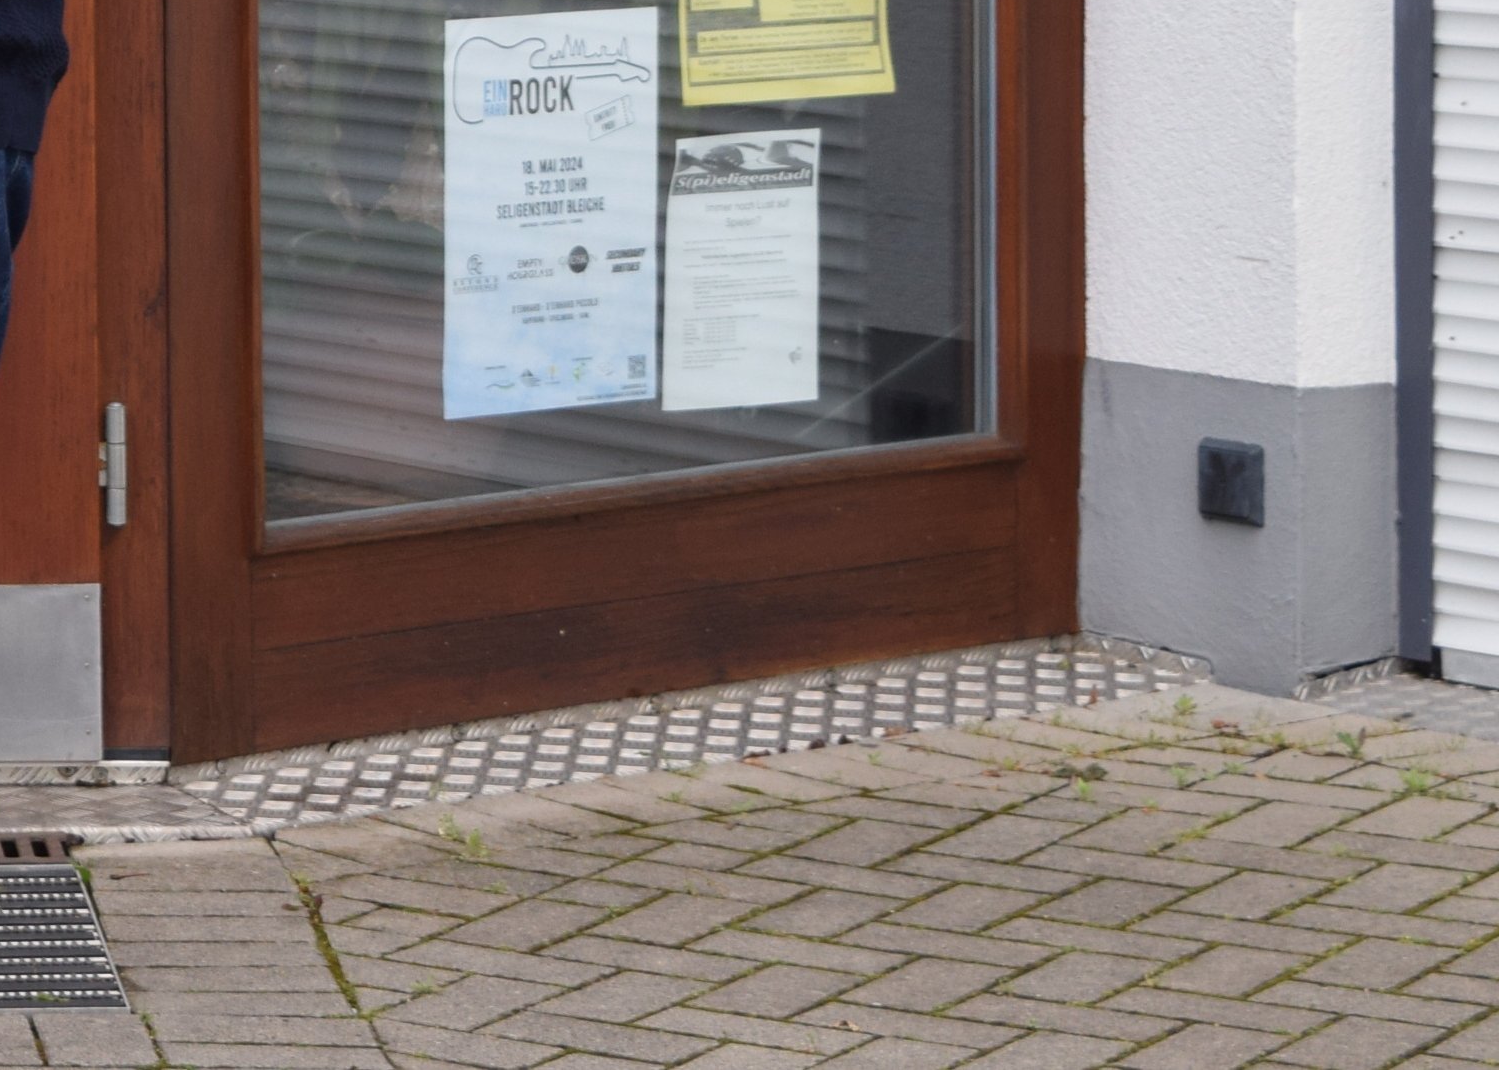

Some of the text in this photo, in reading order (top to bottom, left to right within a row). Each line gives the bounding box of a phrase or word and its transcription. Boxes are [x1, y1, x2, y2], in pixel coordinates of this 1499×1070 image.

[483, 80, 508, 103] EIN
[509, 75, 574, 116] ROCK
[522, 156, 584, 175] 18. MAI 2024
[568, 177, 588, 192] UHR
[675, 167, 812, 191] S(pi)eligenstadt
[496, 196, 606, 220] SELIGENSTADT BLEICHE
